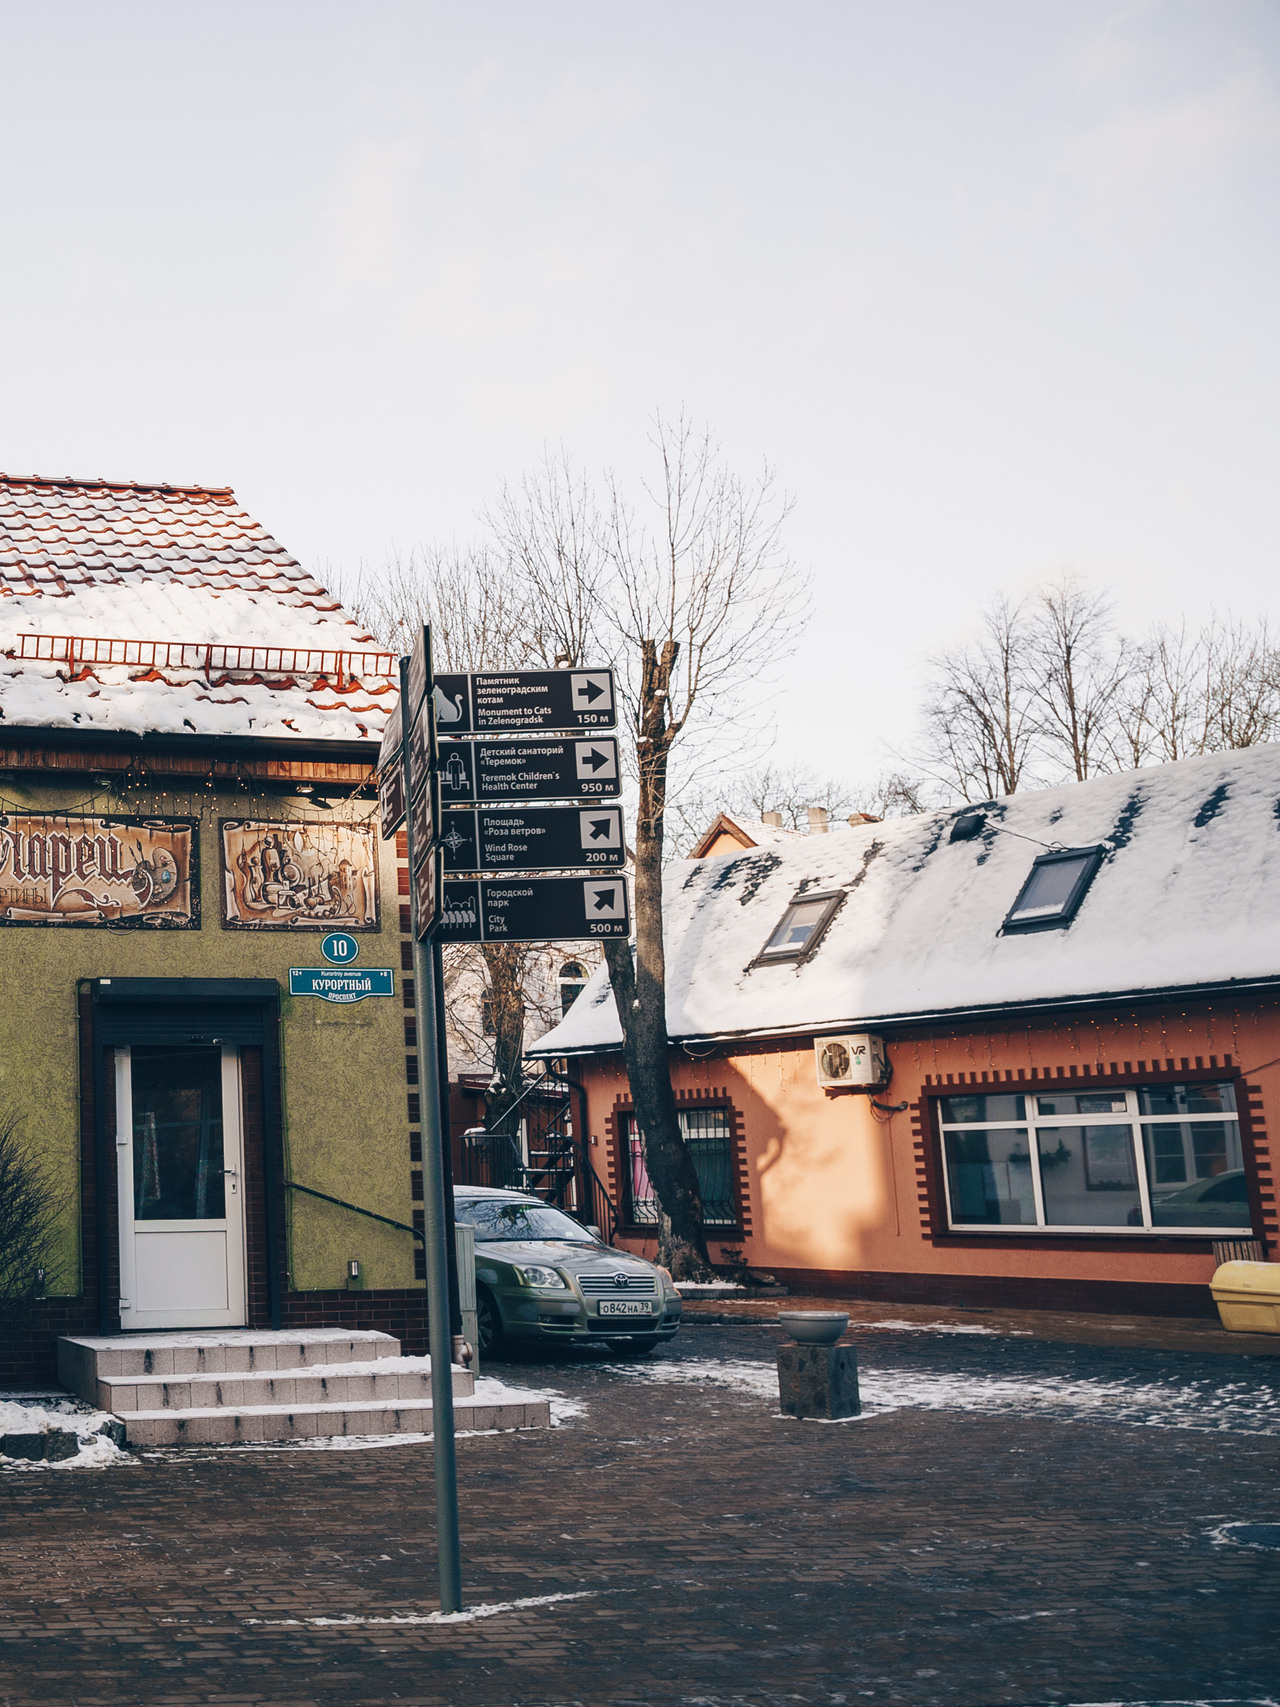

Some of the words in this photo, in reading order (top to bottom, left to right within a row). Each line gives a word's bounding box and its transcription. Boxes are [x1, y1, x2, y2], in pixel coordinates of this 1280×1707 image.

[476, 677, 519, 685] Памятник
[477, 686, 548, 695] зеленоградским
[478, 708, 522, 716] Monument
[534, 706, 552, 714] Cats
[488, 715, 543, 726] Zelenogradsk
[577, 714, 597, 723] 150
[480, 747, 516, 758] Детский
[517, 746, 564, 756] санаторий
[481, 758, 526, 767] «Теремок»
[481, 773, 517, 782] Teremok
[482, 782, 509, 791] Health
[510, 782, 538, 790] Center
[581, 783, 602, 793] 950
[483, 818, 525, 827] Площадь
[484, 827, 509, 835] «Роза
[510, 828, 546, 837] ветров»
[484, 843, 506, 852] Wind
[507, 843, 528, 851] Rose
[485, 853, 515, 863] Square
[585, 852, 607, 862] 200
[487, 887, 533, 899] Городской
[487, 900, 510, 908] парк
[488, 914, 505, 924] City
[489, 924, 508, 933] Park
[590, 923, 612, 933] 500
[332, 940, 348, 956] 10
[312, 978, 372, 991] КУРОРТНЫЙ
[328, 992, 356, 1000] ПРОСПЕКТ
